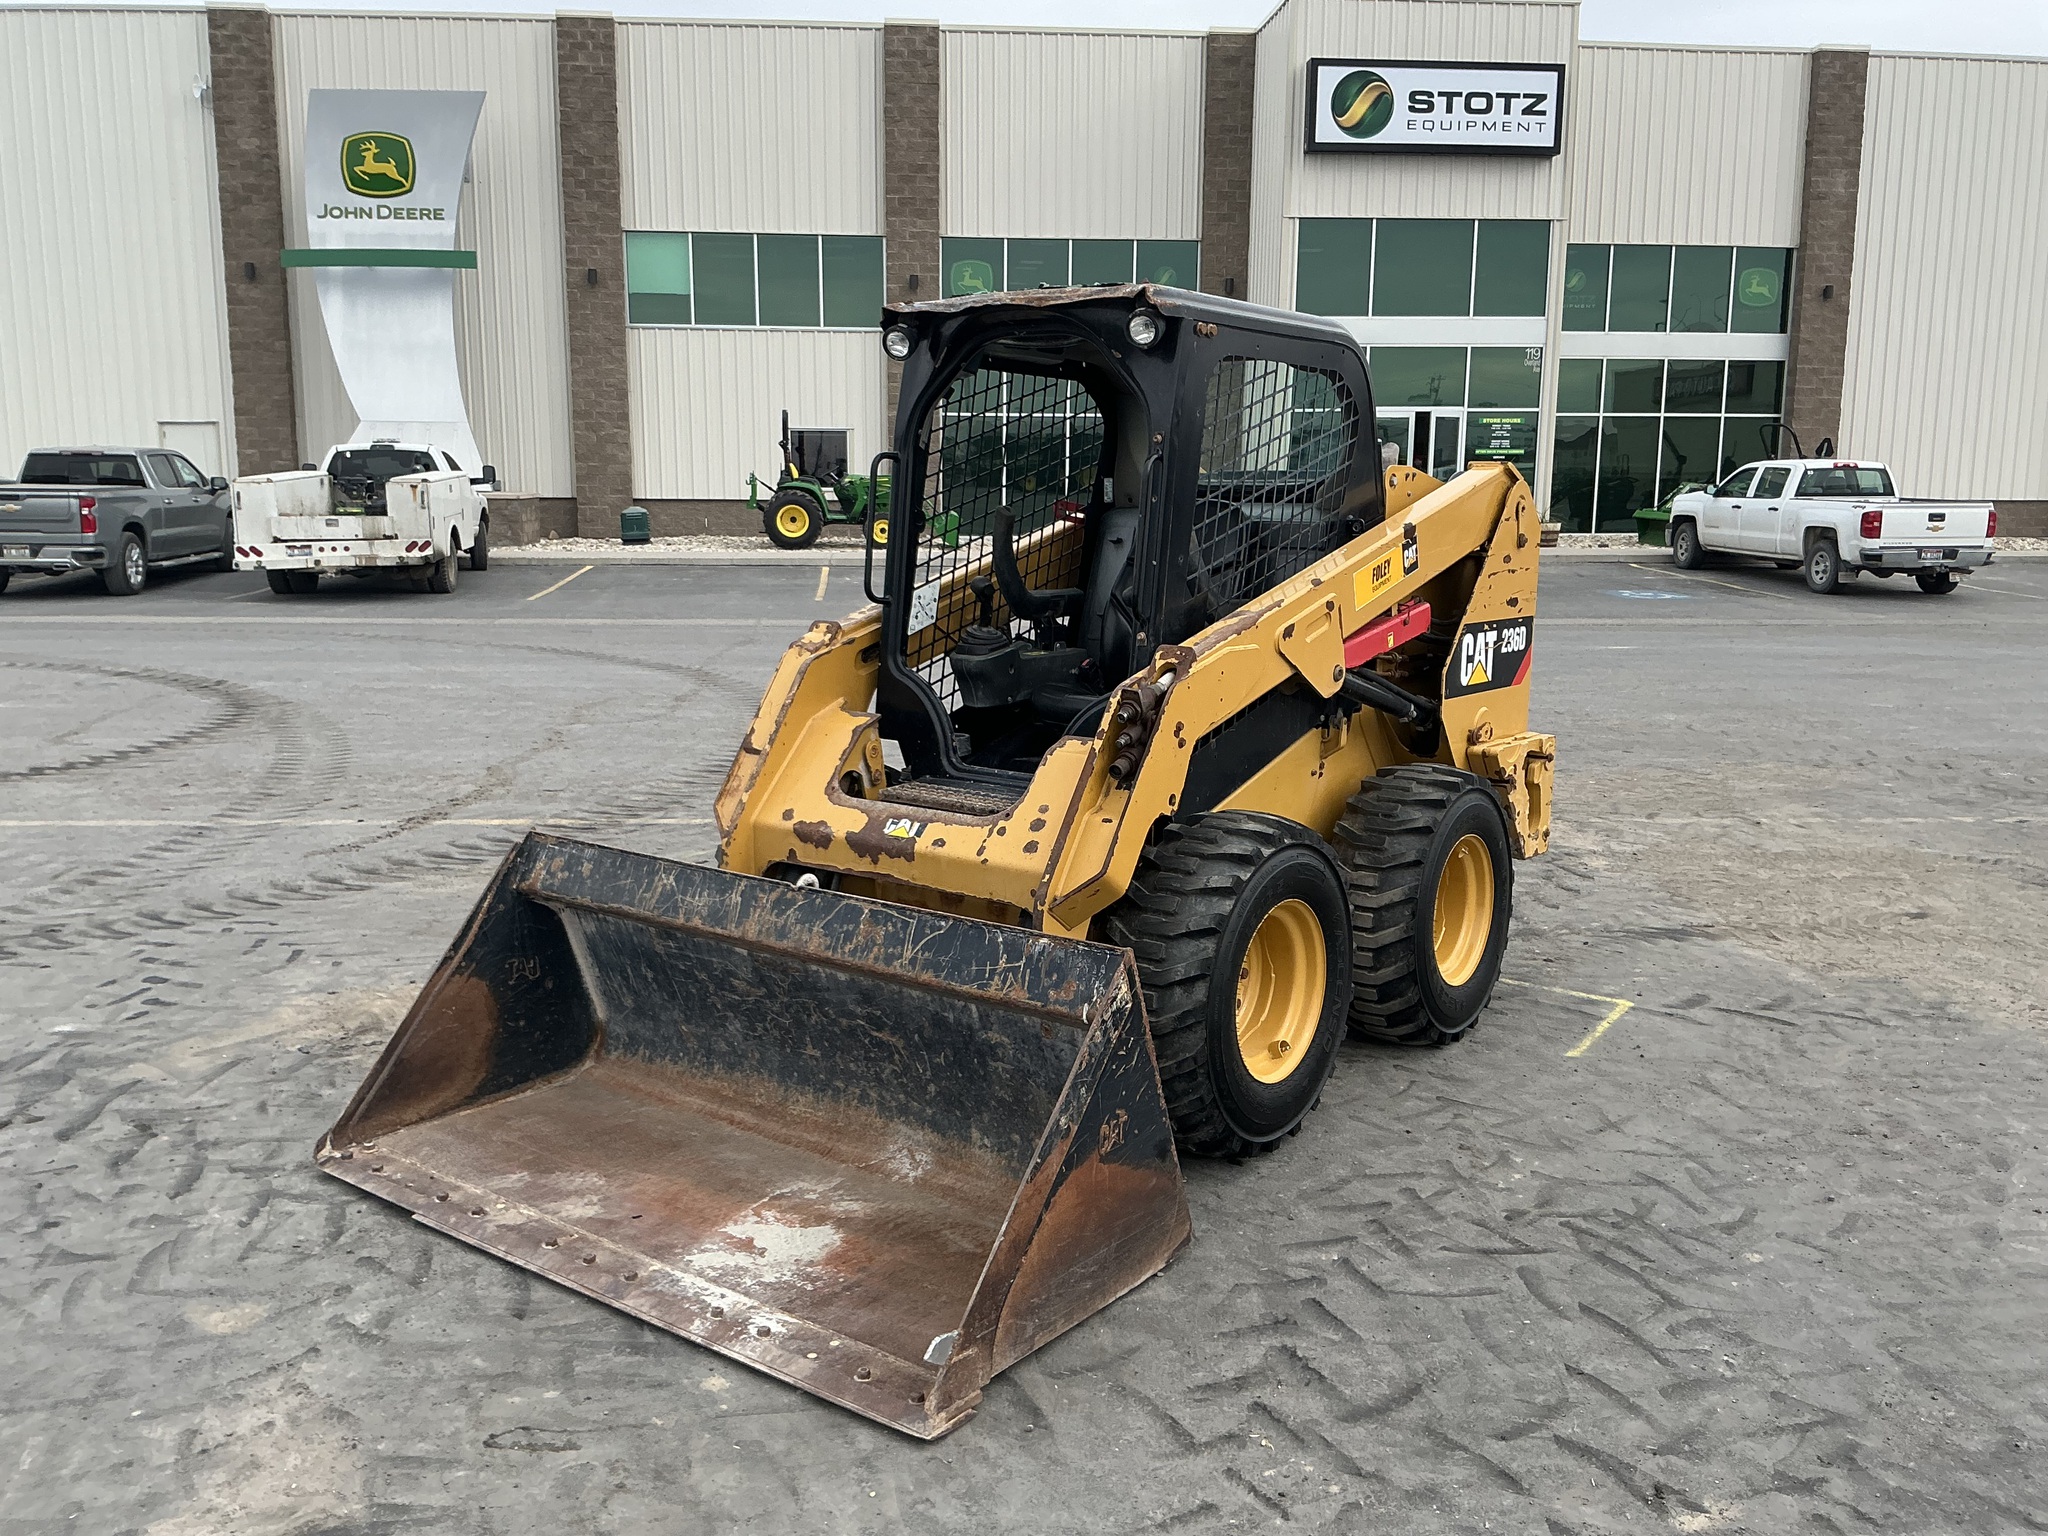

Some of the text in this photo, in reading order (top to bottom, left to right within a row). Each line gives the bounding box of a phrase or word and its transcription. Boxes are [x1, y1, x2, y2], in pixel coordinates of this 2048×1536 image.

[1408, 90, 1548, 116] STOTZ
[1407, 119, 1547, 133] EQUIPMENT
[317, 203, 445, 221] JOHN DEERE
[1525, 348, 1540, 360] 119
[1404, 544, 1417, 568] CAT
[1372, 557, 1392, 584] FOLEY
[1461, 625, 1527, 687] CAT 236D
